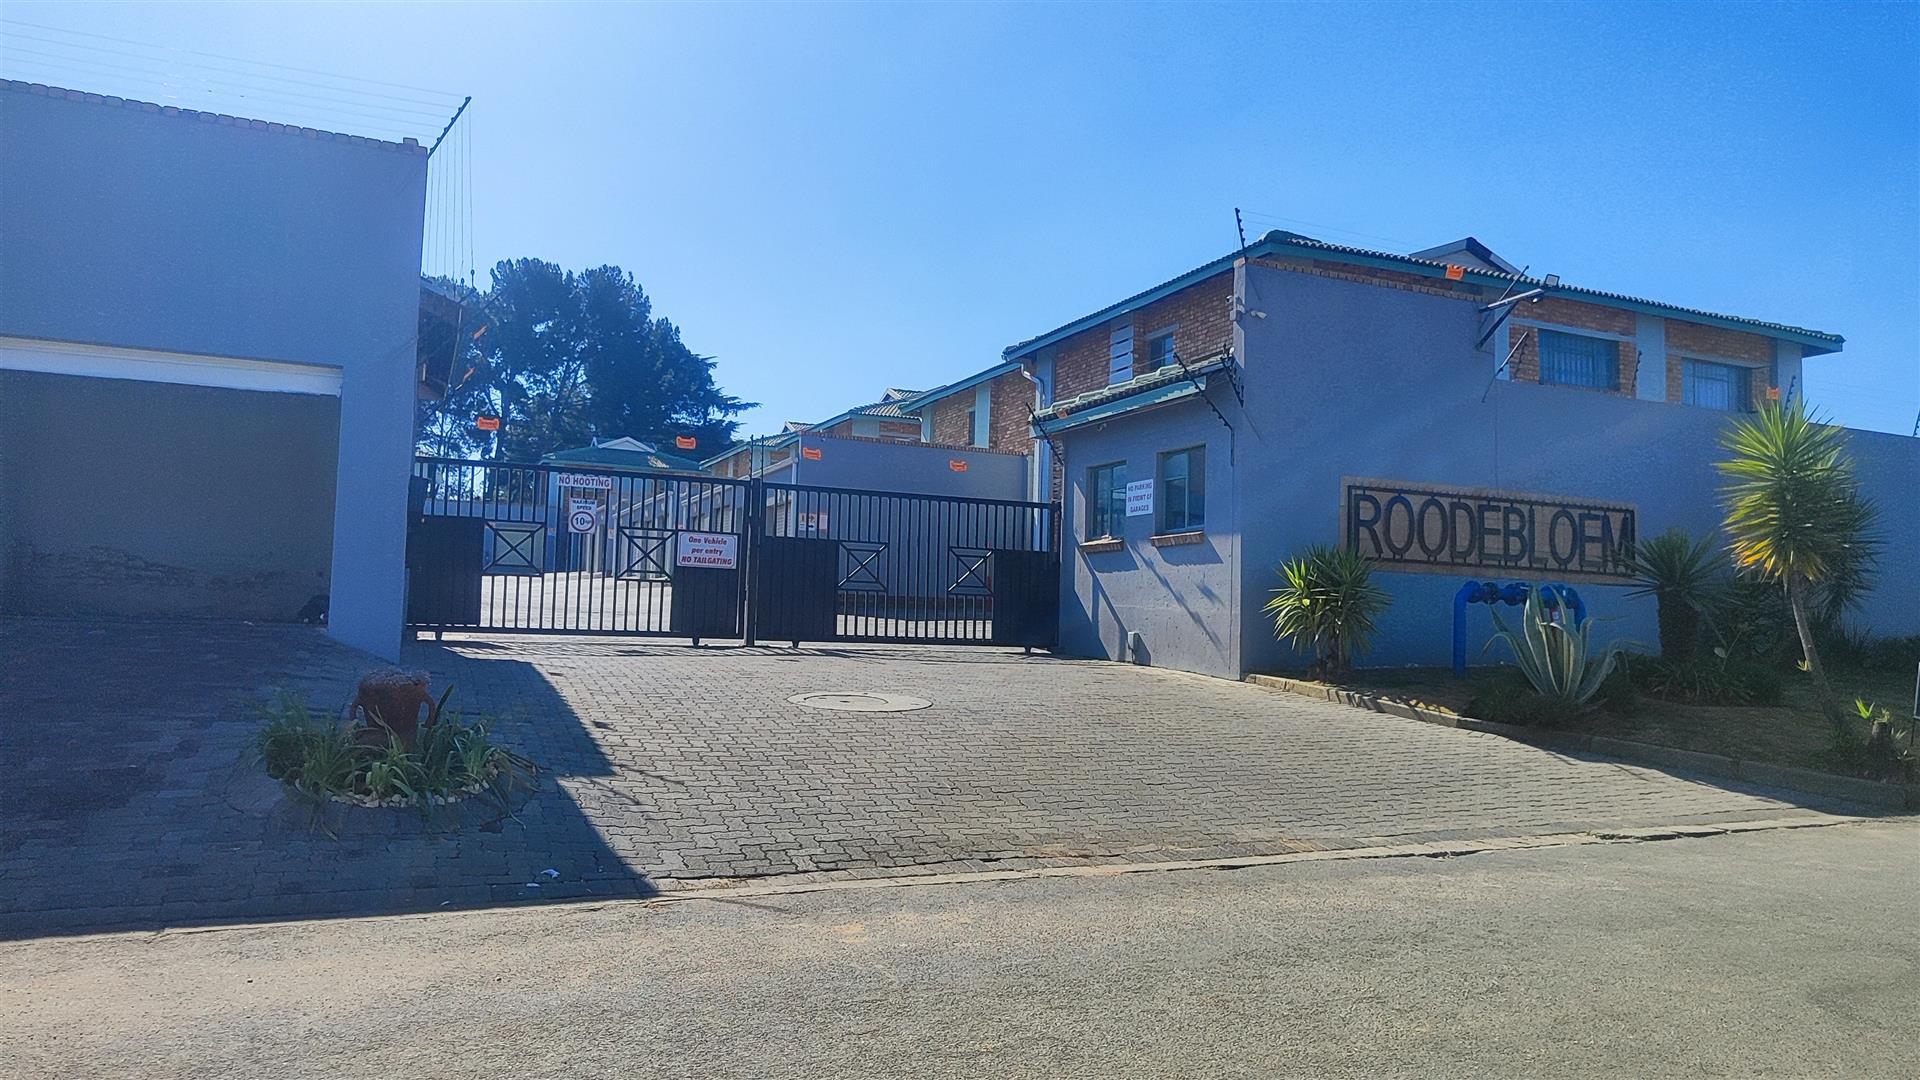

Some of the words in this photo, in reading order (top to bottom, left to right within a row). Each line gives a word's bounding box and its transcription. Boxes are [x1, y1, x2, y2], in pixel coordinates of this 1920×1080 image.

[559, 476, 570, 484] NO
[573, 477, 610, 487] HOOTING
[575, 517, 585, 526] 10
[1353, 494, 1631, 570] ROODEBLOEM
[703, 537, 728, 546] Vehicle
[705, 548, 723, 556] entry
[693, 557, 733, 566] TAILGATING
